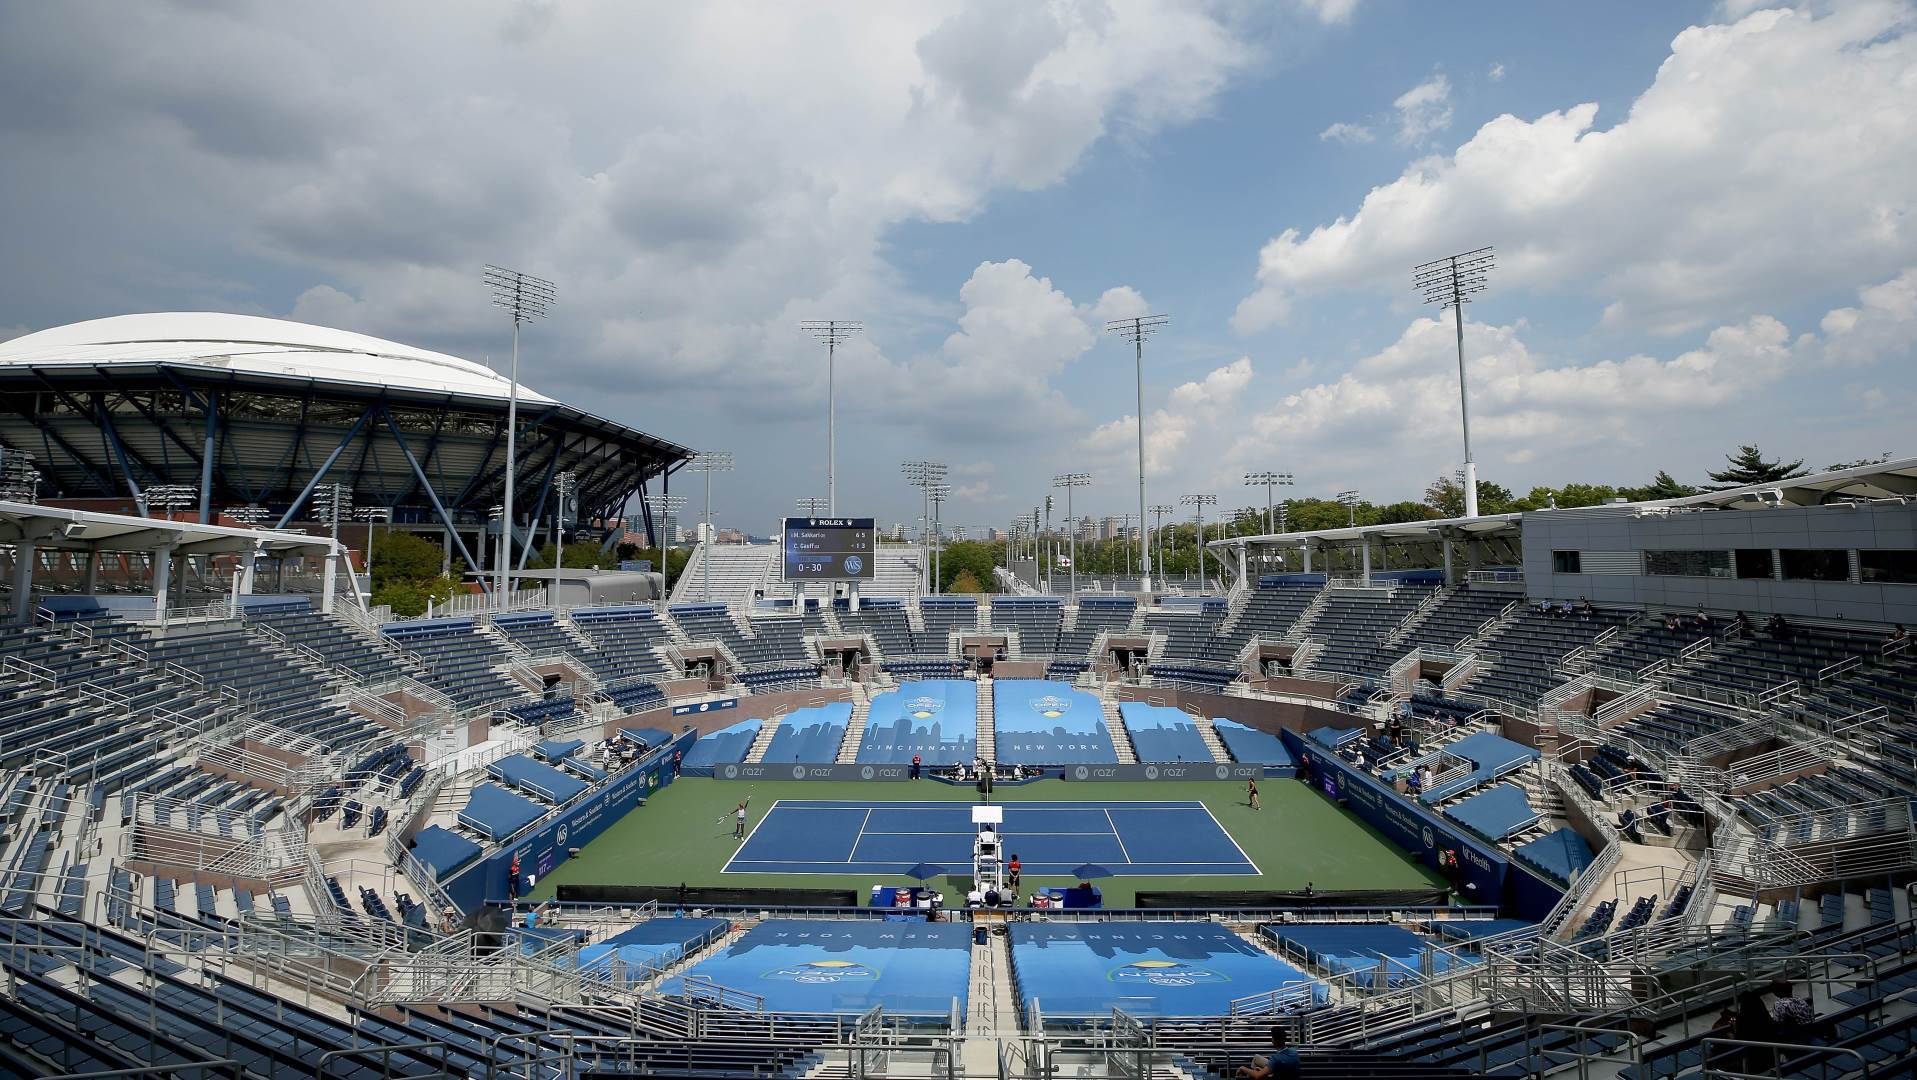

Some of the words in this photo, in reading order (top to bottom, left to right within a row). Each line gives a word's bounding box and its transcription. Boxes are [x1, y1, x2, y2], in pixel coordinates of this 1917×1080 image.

[798, 563, 804, 571] 0
[811, 563, 822, 571] 30
[742, 768, 765, 777] razr
[810, 768, 833, 777] razr
[879, 768, 902, 777] razr
[1093, 768, 1117, 777] razr
[1163, 768, 1187, 777] razr
[1234, 767, 1257, 776] razr
[1471, 852, 1491, 872] Health
